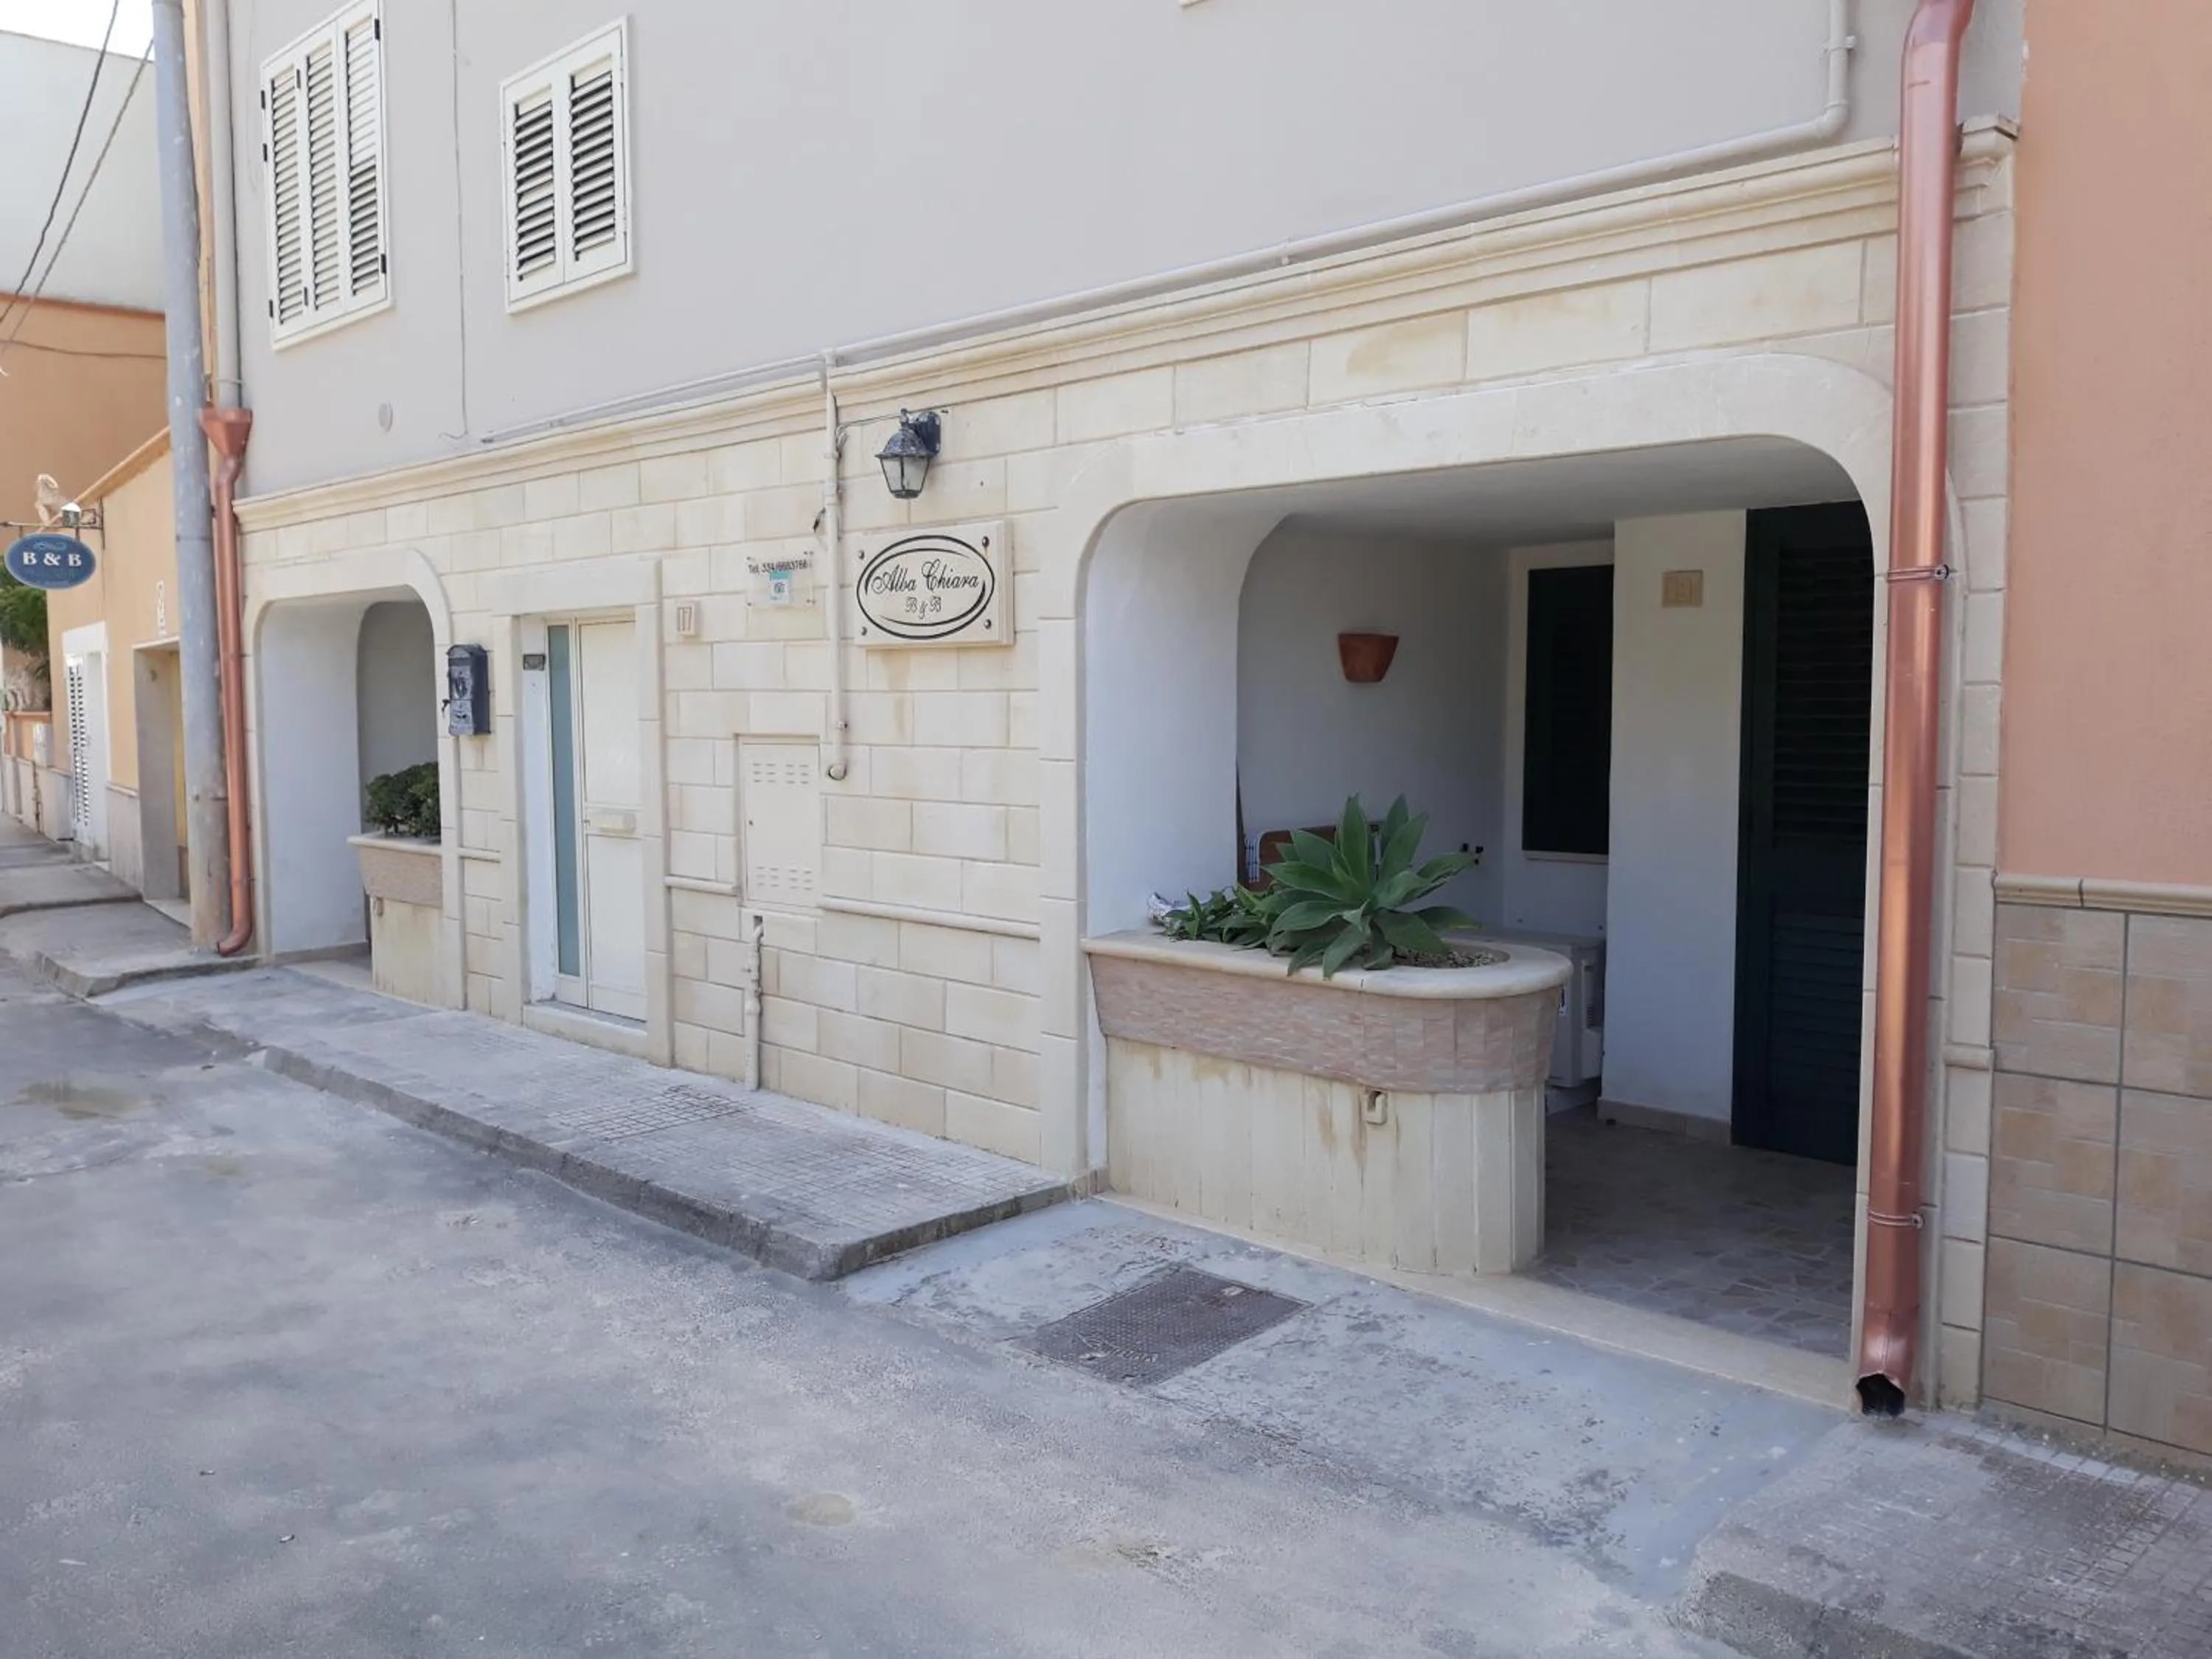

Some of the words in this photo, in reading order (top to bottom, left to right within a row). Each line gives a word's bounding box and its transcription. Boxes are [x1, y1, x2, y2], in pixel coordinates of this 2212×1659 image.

[23, 552, 38, 566] B
[43, 552, 61, 566] &
[68, 554, 83, 567] B
[871, 563, 917, 595] Alba
[921, 558, 979, 592] Chiara
